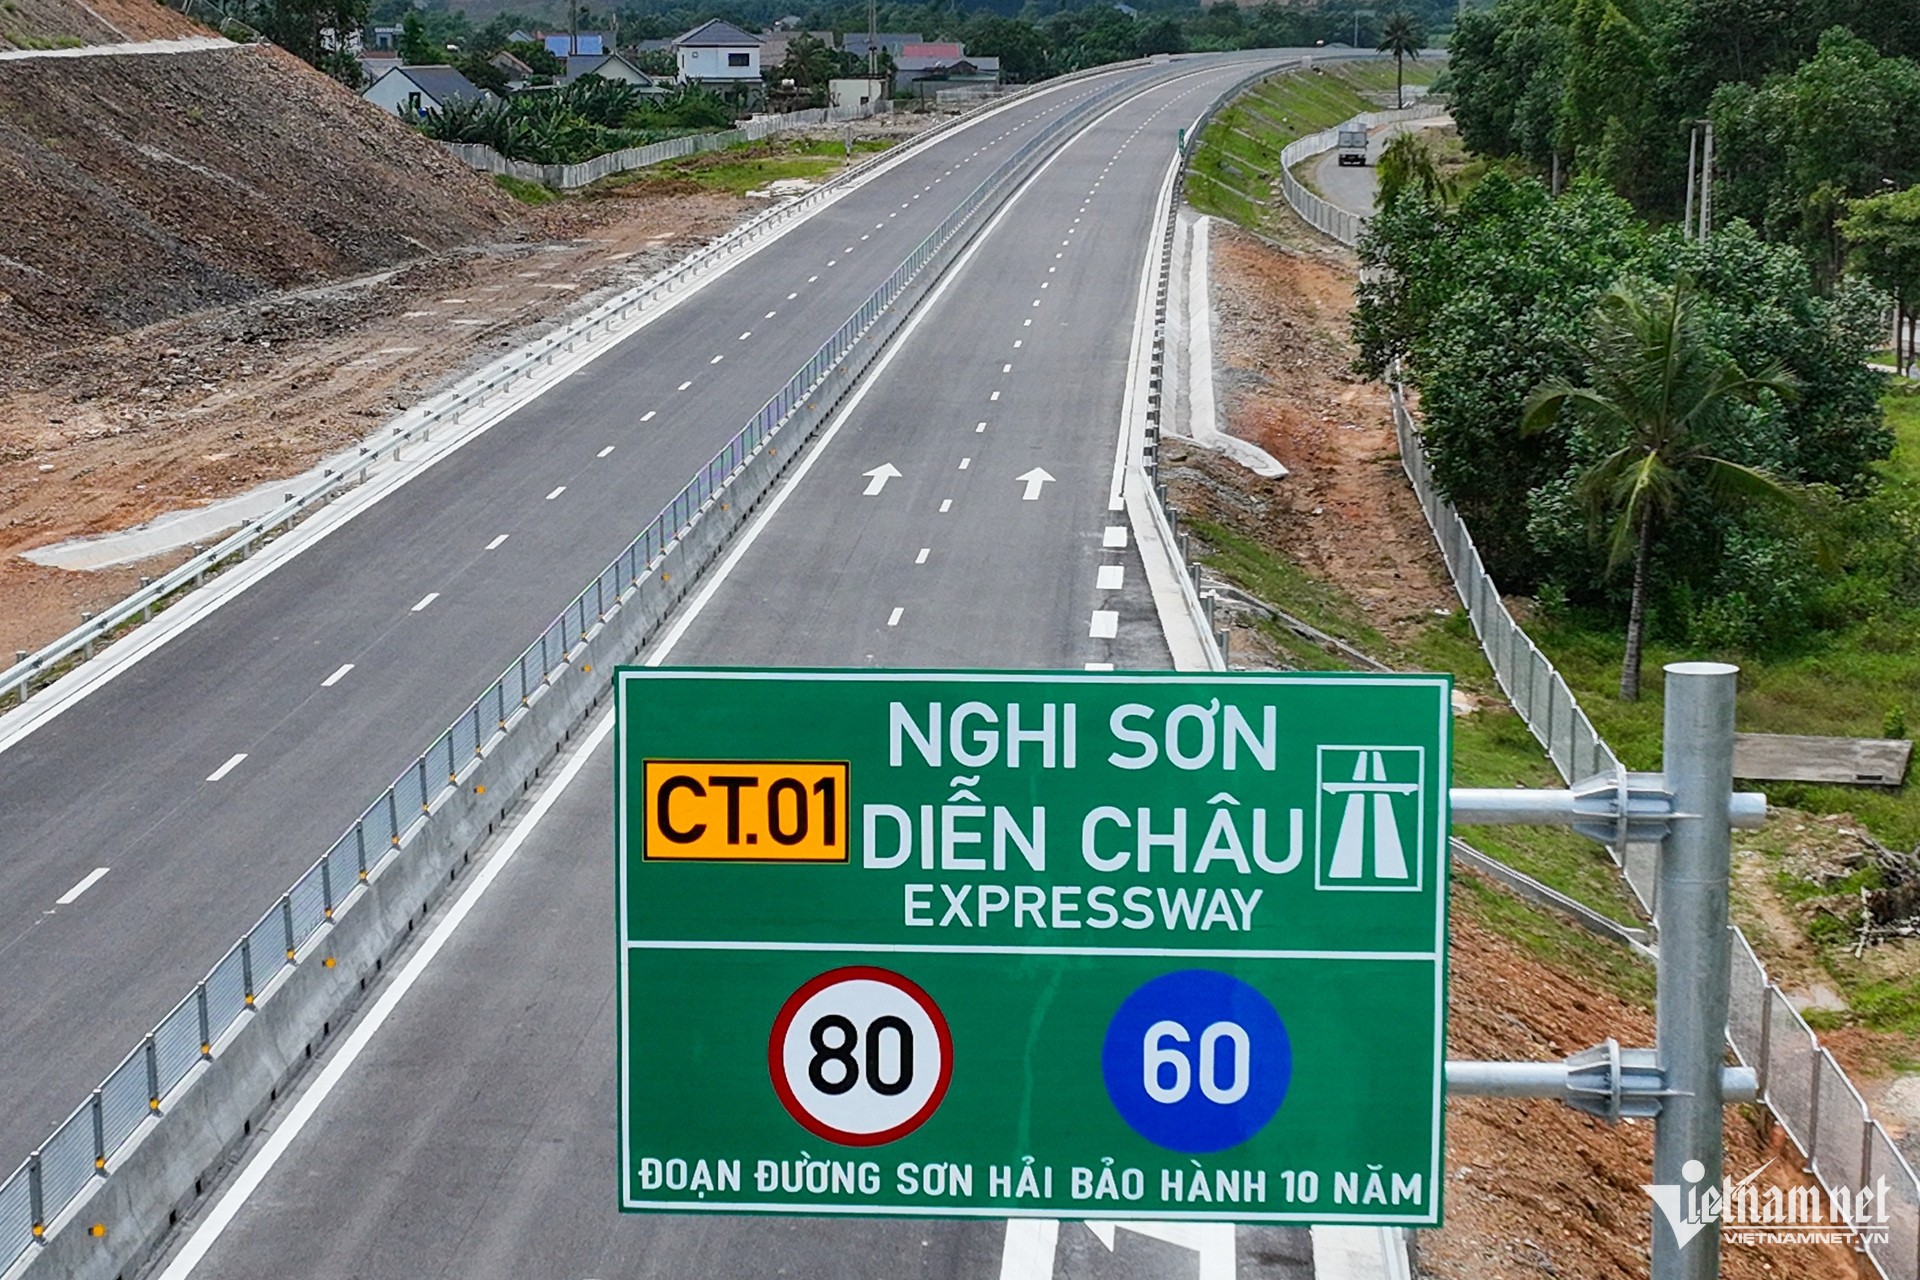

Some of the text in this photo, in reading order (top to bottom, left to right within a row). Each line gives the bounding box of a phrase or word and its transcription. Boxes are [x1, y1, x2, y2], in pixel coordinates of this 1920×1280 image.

[890, 698, 1275, 770] NGHI SƠN
[658, 776, 834, 845] CT.01
[864, 776, 1302, 873] DIỄN CHÂU
[905, 884, 1262, 930] EXPRESSWAY
[809, 1015, 913, 1095] 80
[1144, 1021, 1249, 1103] 60
[638, 1152, 1421, 1204] ĐOẠN ĐƯỜNG SƠN HẢI BẢO HÀNH 10 NĂM
